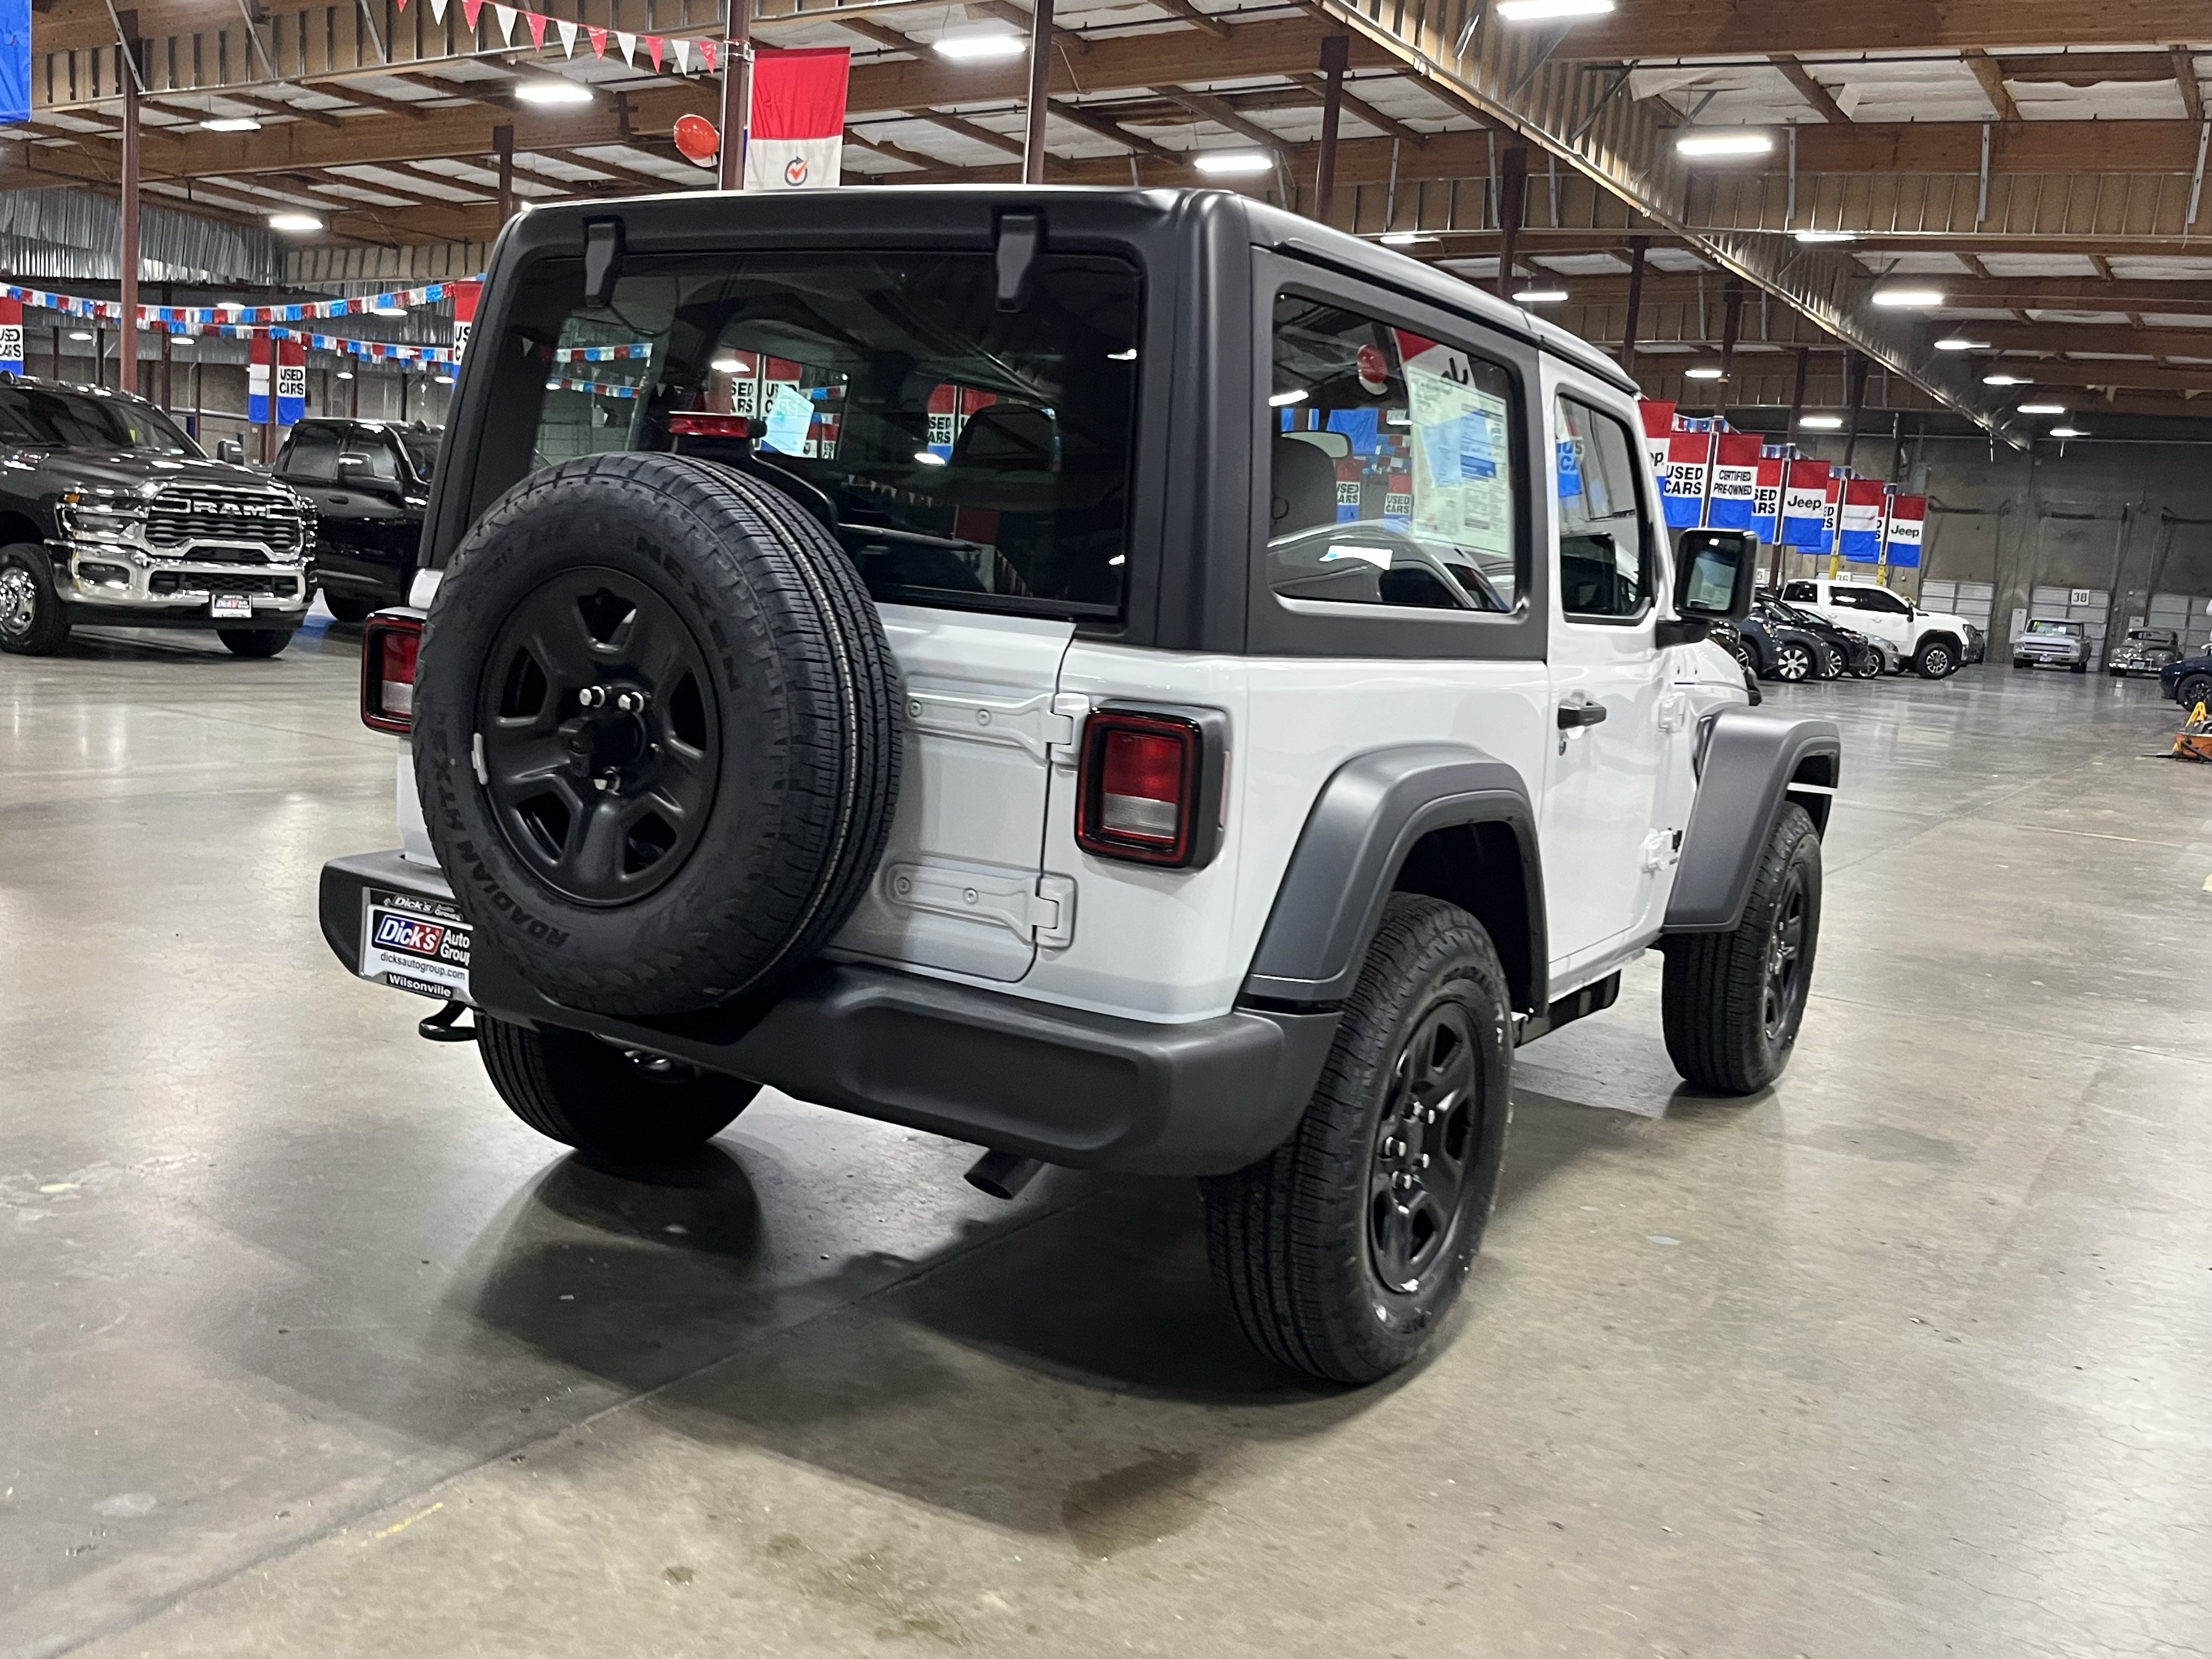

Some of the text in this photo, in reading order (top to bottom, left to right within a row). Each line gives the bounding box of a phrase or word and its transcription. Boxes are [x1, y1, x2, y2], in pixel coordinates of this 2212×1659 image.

[280, 369, 303, 381] USED
[929, 416, 951, 430] SED
[1666, 465, 1703, 480] USED
[1719, 469, 1751, 482] CERTIFIED
[1664, 479, 1702, 495] CARS
[1713, 482, 1752, 495] PRE-OWNED
[1387, 495, 1410, 505] USED
[1787, 495, 1822, 511] Jeep
[193, 501, 267, 517] RAM
[1386, 505, 1409, 514] CARS
[1891, 525, 1920, 538] Jeep
[2073, 592, 2087, 602] 38
[456, 839, 570, 947] ROADIAN
[394, 896, 432, 912] Dick's
[380, 919, 470, 950] Dick's Auto
[380, 952, 466, 980] dicksautogroup.com
[389, 973, 452, 997] Wilsonville
